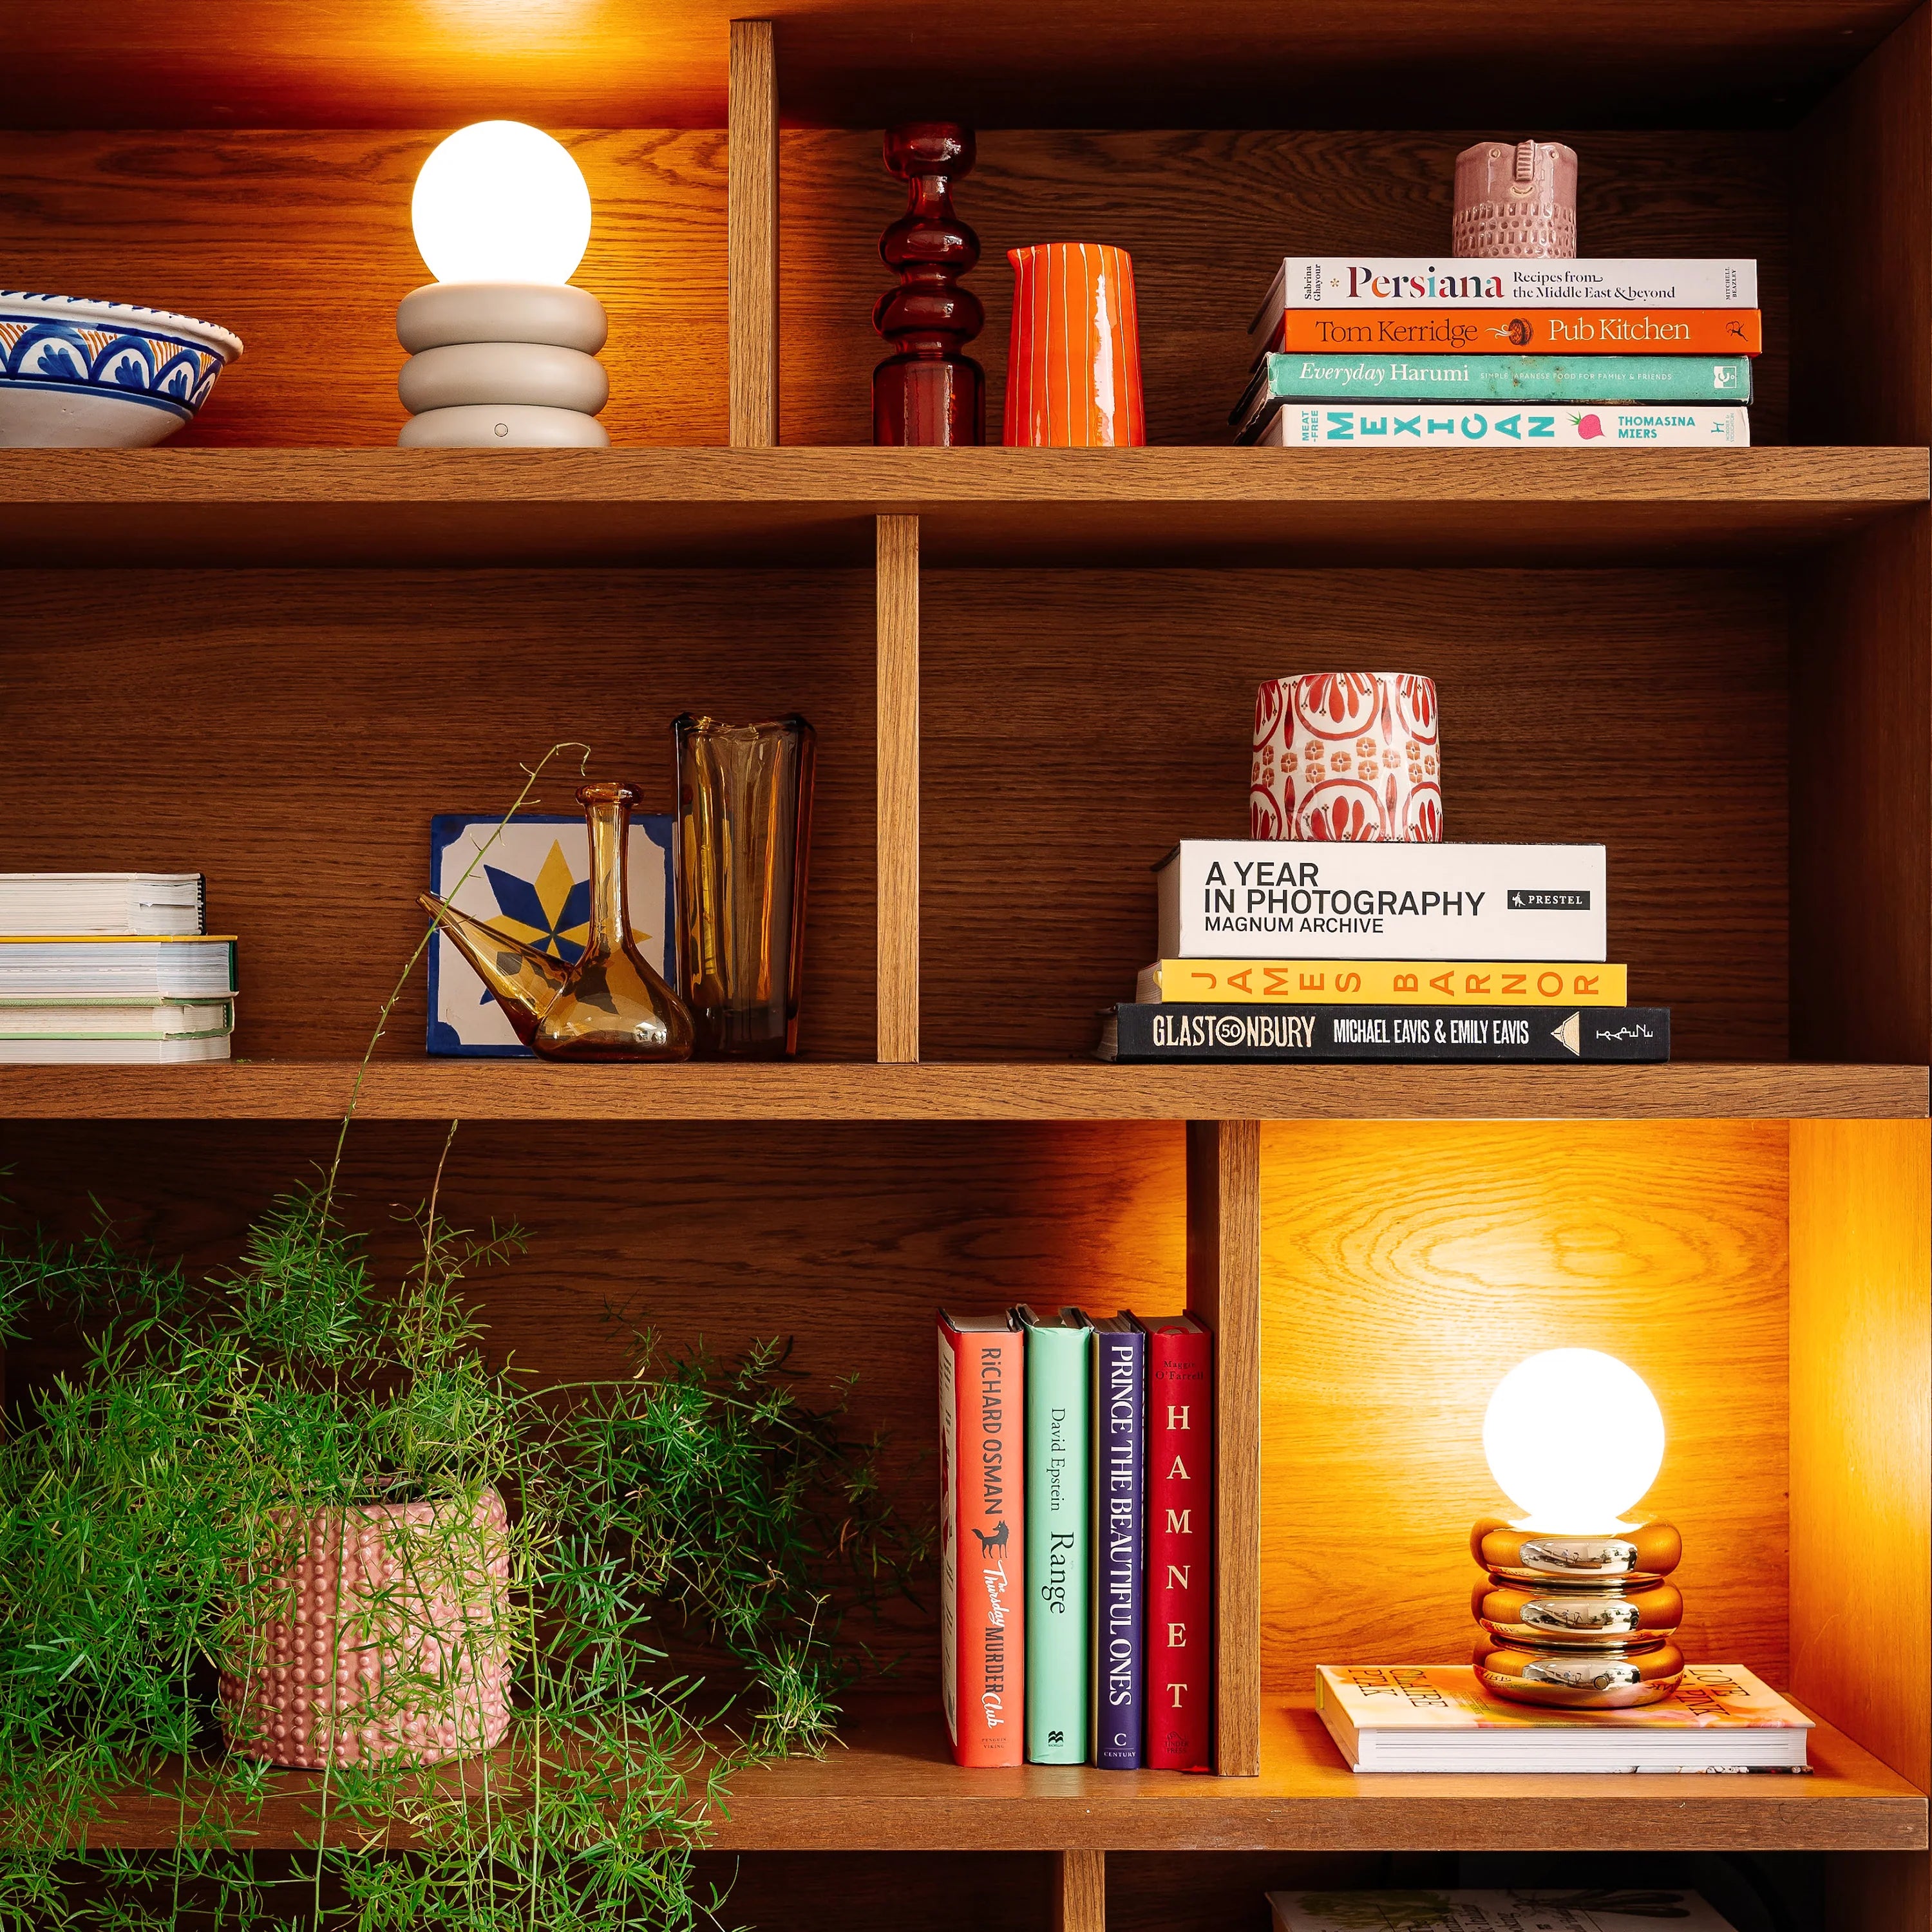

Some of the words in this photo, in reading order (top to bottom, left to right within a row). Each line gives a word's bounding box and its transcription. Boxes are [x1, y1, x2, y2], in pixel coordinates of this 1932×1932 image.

[1314, 265, 1322, 301] Ghayour
[1347, 266, 1505, 298] Persiana
[1514, 272, 1562, 285] Recipes
[1566, 271, 1603, 282] from
[1513, 287, 1533, 298] the
[1537, 287, 1581, 298] Middle
[1586, 287, 1611, 298] East
[1615, 287, 1636, 301] &
[1629, 287, 1675, 301] beyond
[1316, 321, 1372, 342] Tom
[1378, 318, 1478, 348] Kerridge
[1549, 317, 1595, 341] Pub
[1599, 316, 1690, 340] Kitchen
[1299, 363, 1385, 386] Everyday
[1390, 365, 1469, 381] Harumi
[1327, 412, 1555, 440] MEXICAN
[1618, 417, 1695, 426] THOMASINA
[1619, 429, 1657, 438] MIERS
[1206, 862, 1226, 886] A
[1234, 862, 1318, 887] YEAR
[1205, 889, 1234, 913] IN
[1248, 889, 1485, 916] PHOTOGRAPHY
[1528, 896, 1582, 904] PRESTEL
[1206, 916, 1293, 932] MAGNUM
[1300, 918, 1383, 933] ARCHIVE
[1191, 968, 1361, 996] JAMES
[1394, 971, 1598, 997] BARNOR
[1221, 1024, 1240, 1038] 50
[1334, 1019, 1390, 1043] MICHAEL
[1394, 1019, 1430, 1043] EAVIS
[1434, 1019, 1446, 1043] &
[1450, 1020, 1488, 1043] EMILY
[1493, 1020, 1529, 1044] EAVIS
[1164, 1360, 1196, 1369] Maggie
[1110, 1346, 1133, 1434] PRINCE
[1052, 1408, 1065, 1452] David
[983, 1439, 1002, 1514] OSMAN
[1110, 1440, 1132, 1492] THE
[1046, 1458, 1065, 1510] Epstein
[1109, 1498, 1132, 1635] BEAUTIFUL
[1166, 1406, 1192, 1707] HAMNET
[1042, 1532, 1074, 1613] Range
[983, 1560, 1009, 1628] Thursday
[985, 1627, 1005, 1692] MURDER
[1108, 1639, 1132, 1706] ONES
[1348, 1669, 1398, 1696] PTAK
[1389, 1669, 1448, 1707] CLAIRE
[1688, 1669, 1750, 1696] LOVE
[981, 1692, 1005, 1729] Club
[1675, 1689, 1730, 1716] PINK
